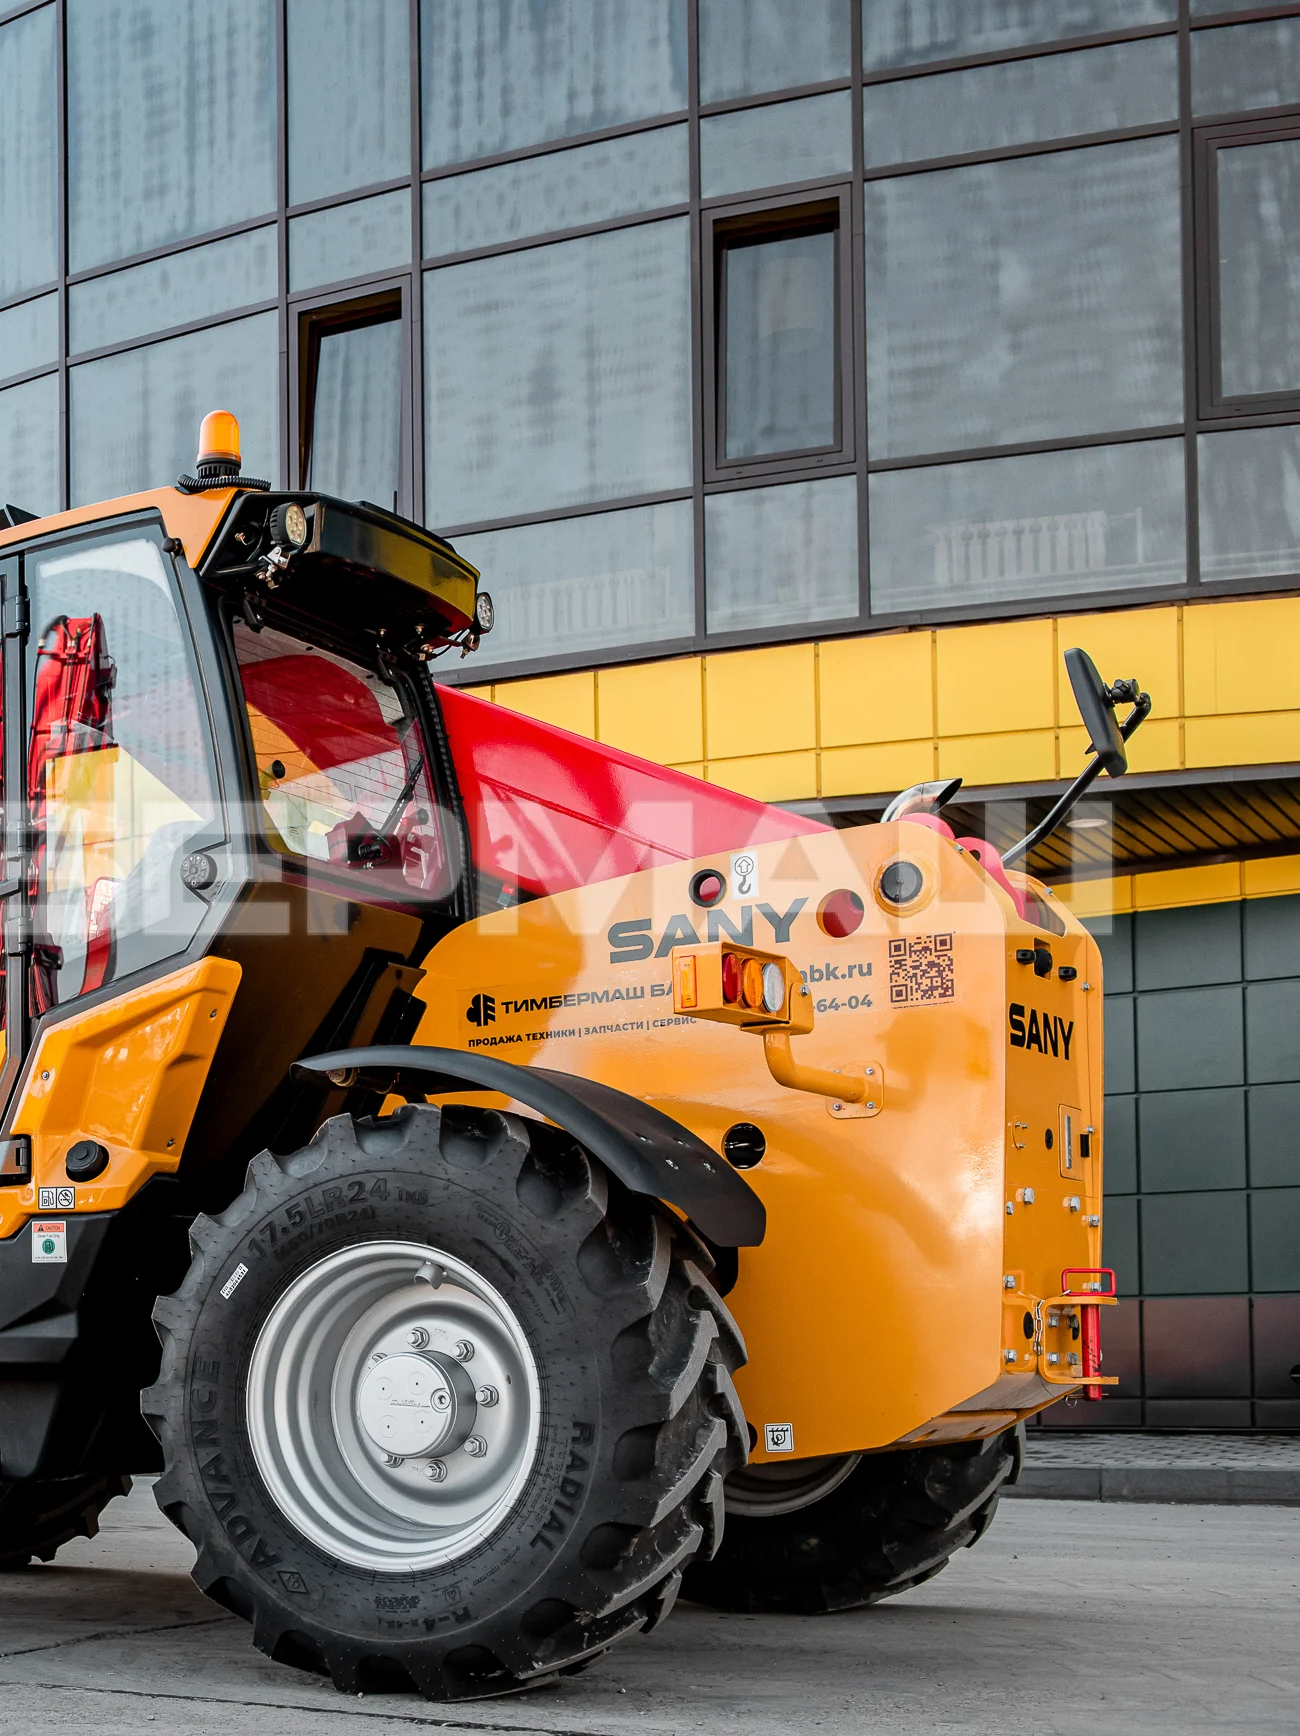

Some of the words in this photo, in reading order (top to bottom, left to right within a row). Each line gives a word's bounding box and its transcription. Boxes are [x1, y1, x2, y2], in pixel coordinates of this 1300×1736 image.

[607, 897, 810, 965] SANY
[468, 1034, 523, 1048] ПРОДАЖА
[525, 1027, 576, 1041] ТЕХНИКИ
[584, 1020, 644, 1036] ЗАПЧАСТИ
[652, 1016, 697, 1029] СЕРВИС
[501, 985, 645, 1015] ТИМБЕРМАШ
[1008, 1002, 1074, 1061] SANY
[248, 1178, 391, 1259] 17.5LR24
[191, 1355, 283, 1571] ADVANCE
[529, 1421, 596, 1551] RADIAL
